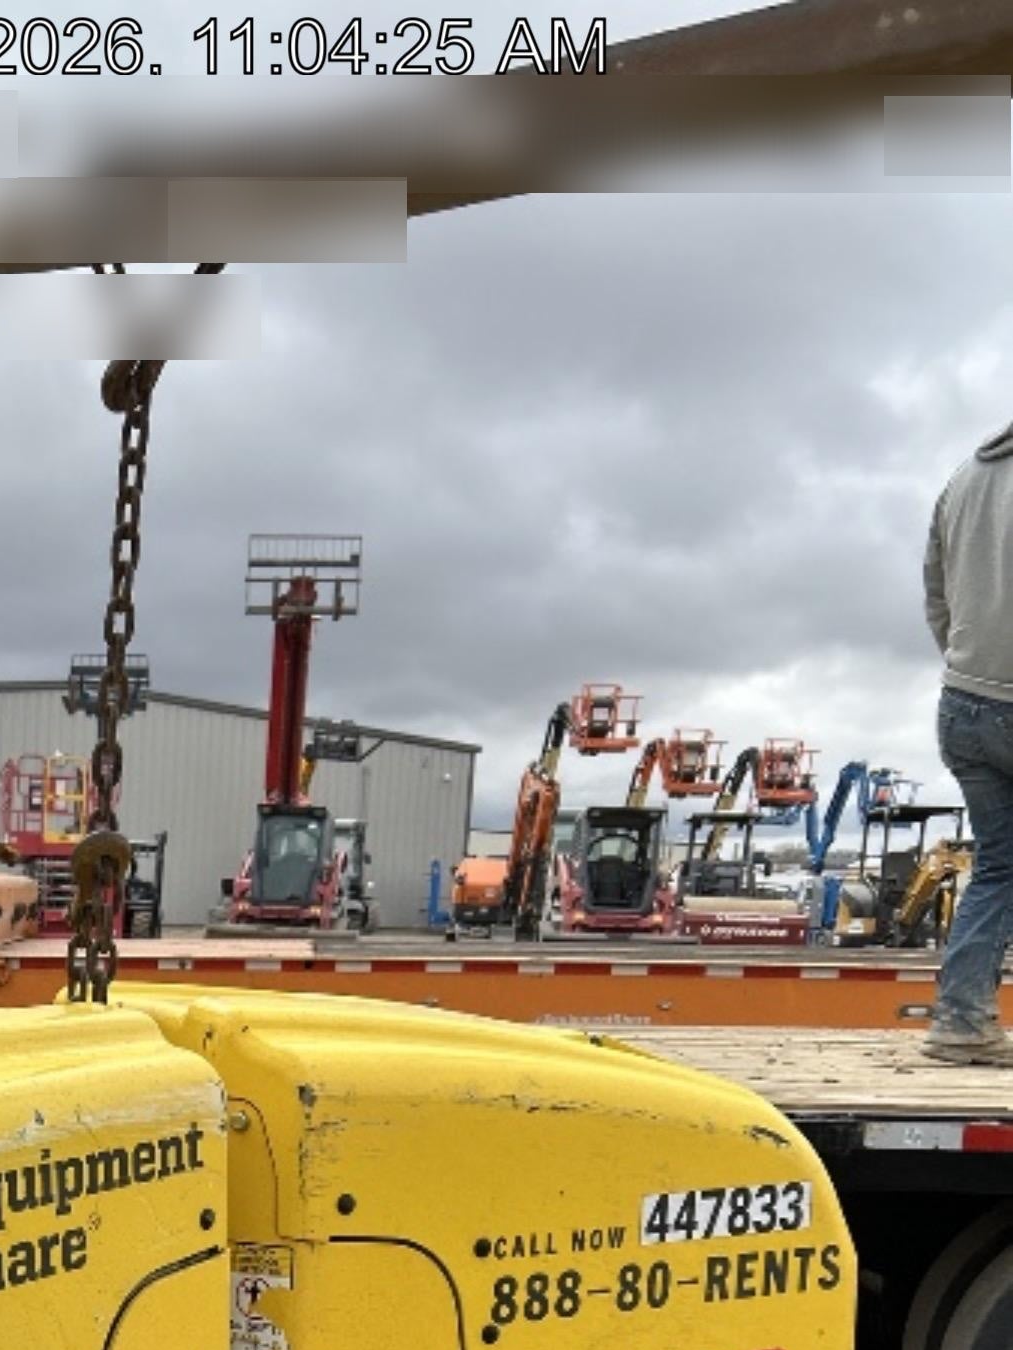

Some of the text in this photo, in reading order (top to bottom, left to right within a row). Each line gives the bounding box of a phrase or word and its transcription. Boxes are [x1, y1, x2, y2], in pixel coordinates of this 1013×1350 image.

[493, 1225, 627, 1259] CALL NOW
[644, 1181, 806, 1243] 447833
[490, 1243, 841, 1325] 888-80-RENTS
